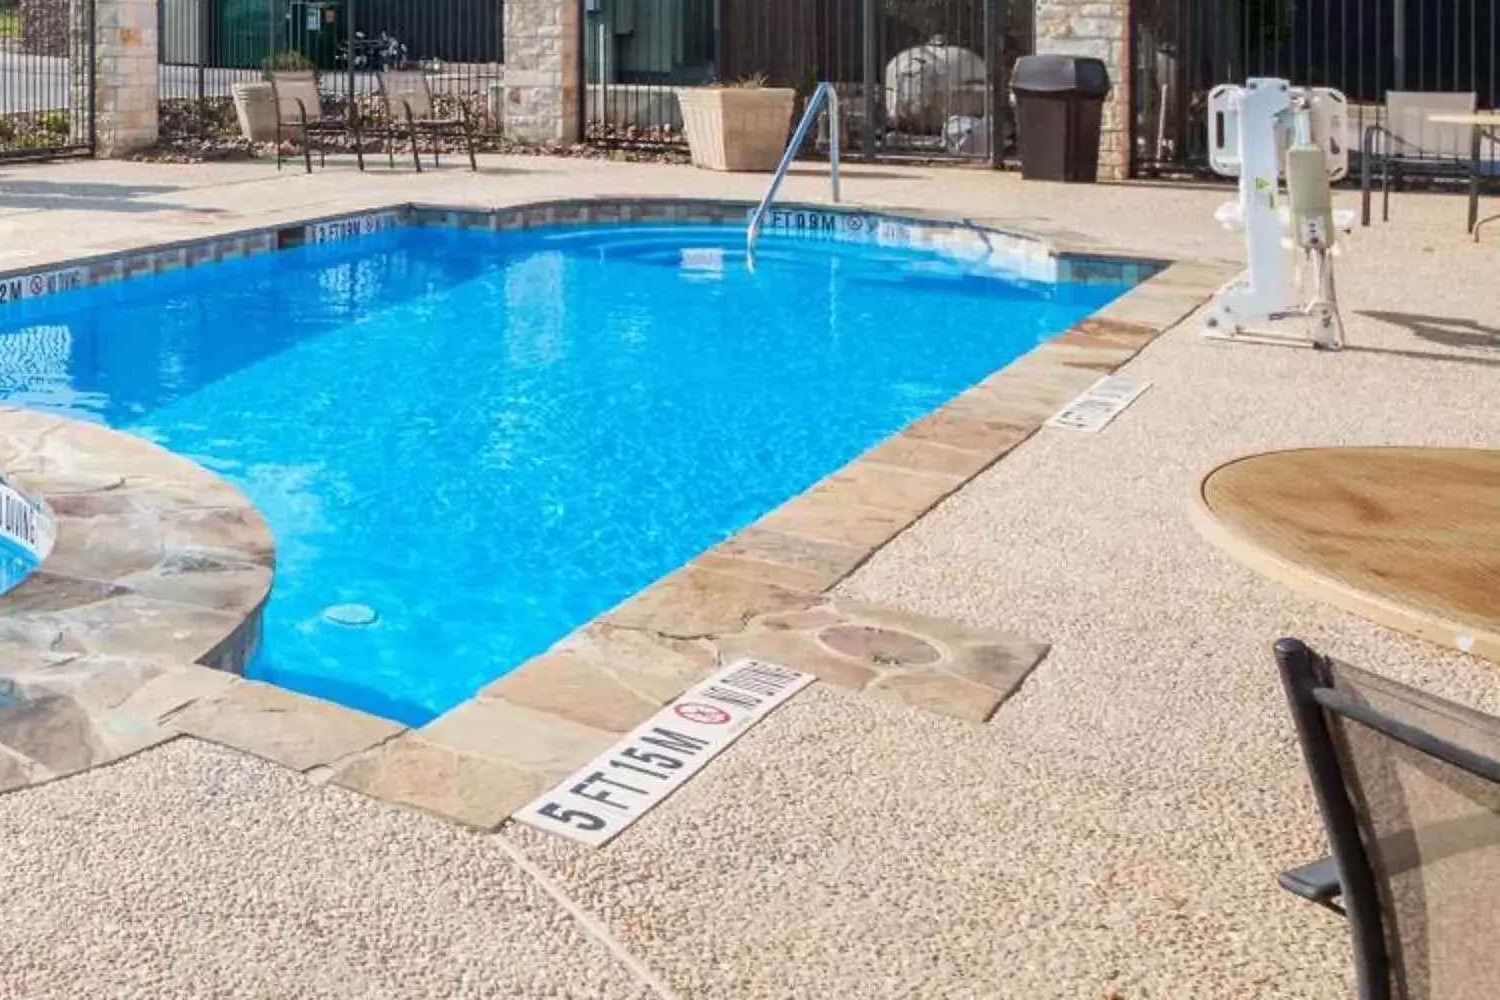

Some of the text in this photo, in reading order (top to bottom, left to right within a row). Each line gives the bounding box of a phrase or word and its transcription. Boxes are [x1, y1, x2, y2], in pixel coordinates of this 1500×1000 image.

[10, 280, 21, 301] M
[640, 726, 711, 757] M
[569, 771, 649, 811] FT
[537, 801, 608, 832] 5
